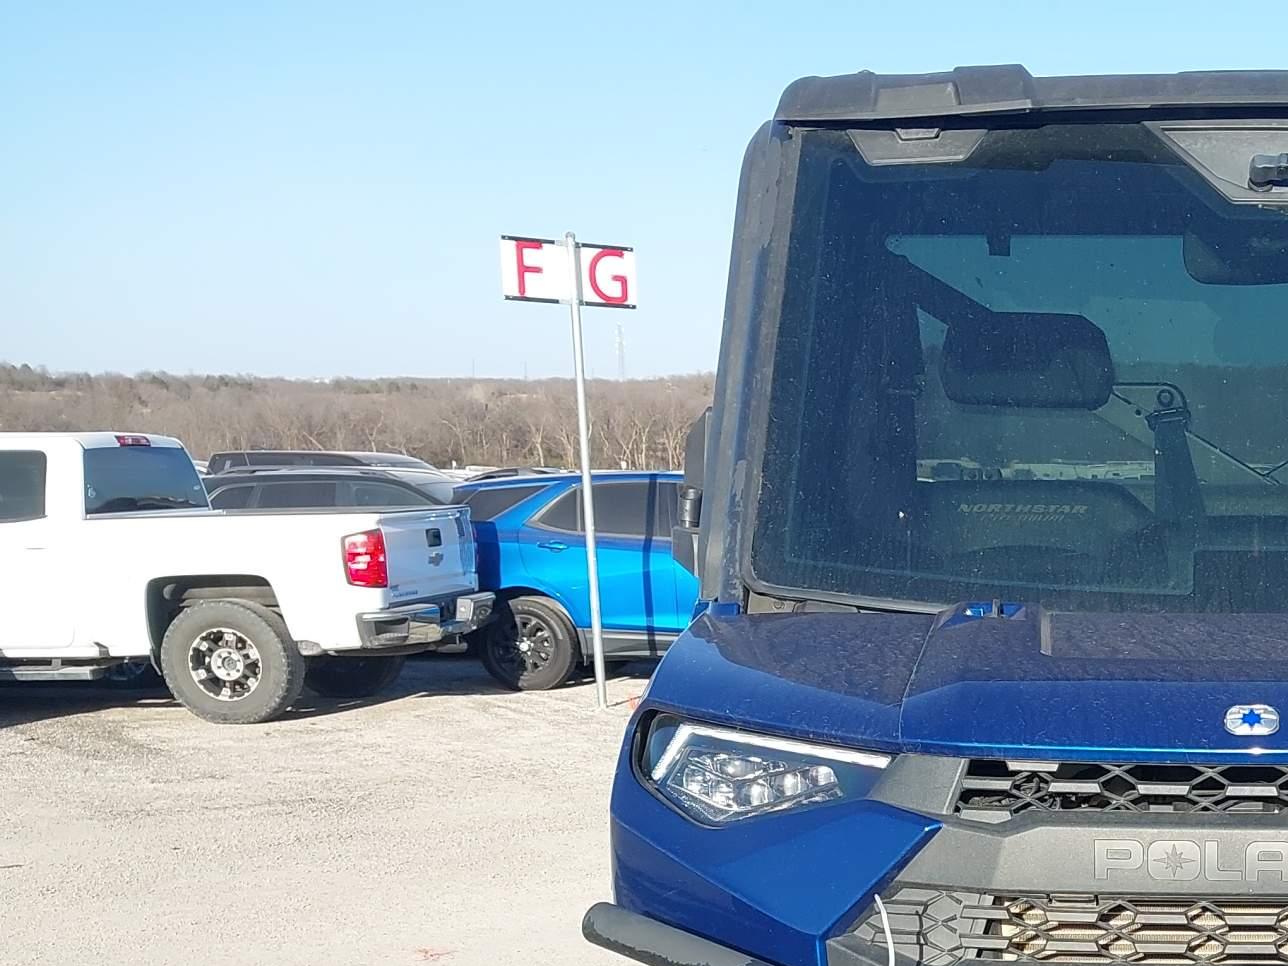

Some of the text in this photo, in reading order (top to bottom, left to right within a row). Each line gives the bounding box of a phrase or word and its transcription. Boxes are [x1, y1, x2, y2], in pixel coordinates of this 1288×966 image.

[515, 240, 628, 304] F G
[957, 503, 1089, 514] NORTHSTAR
